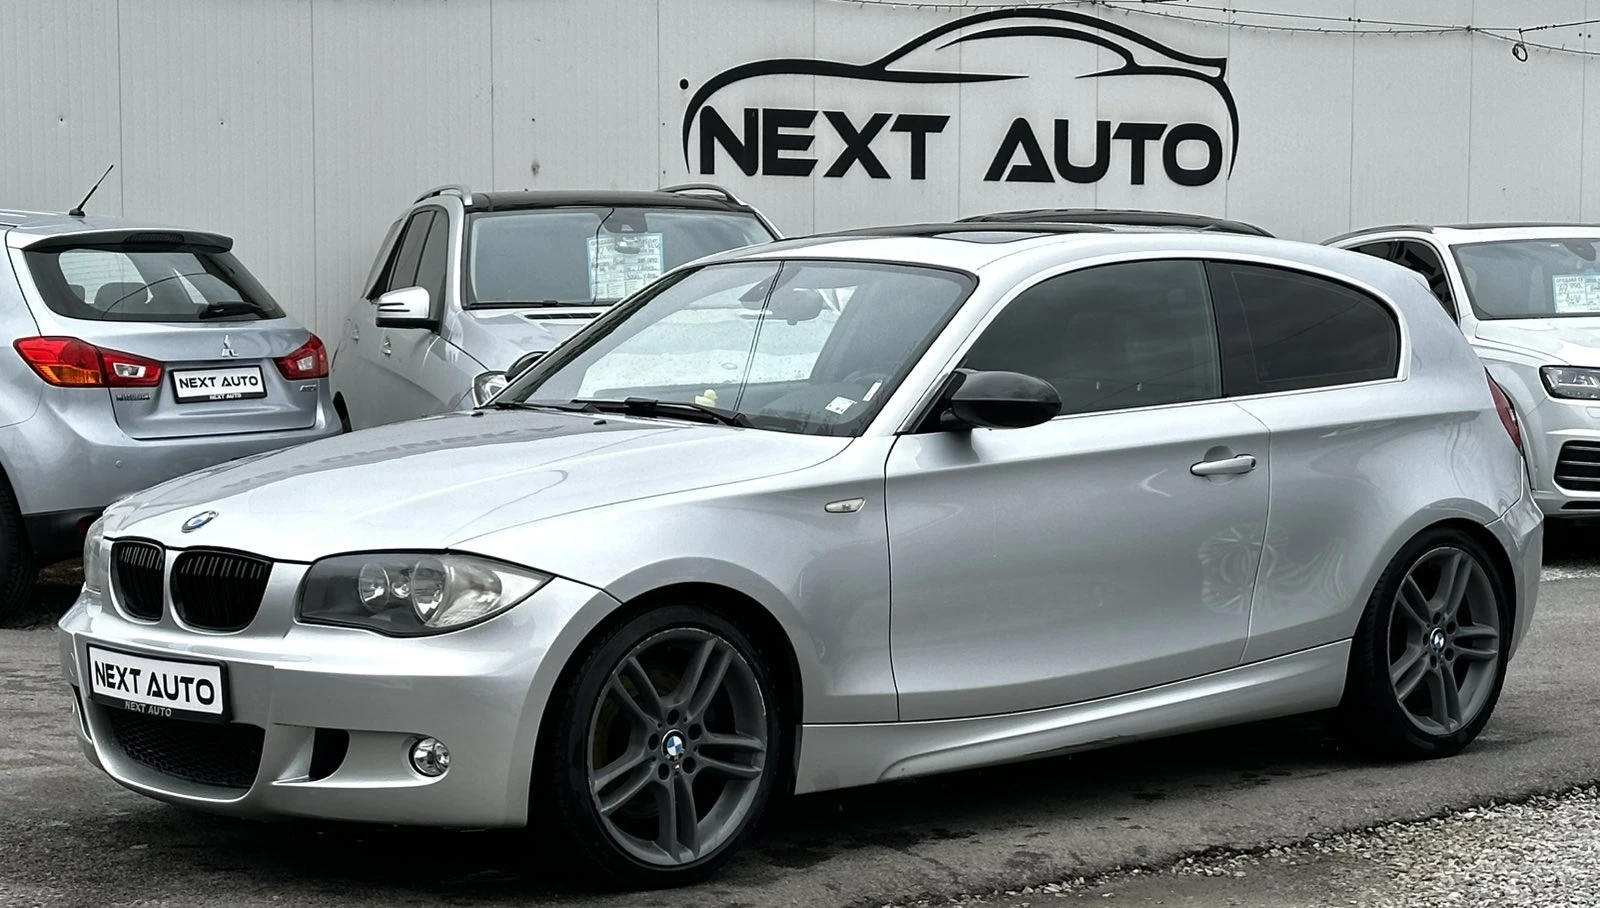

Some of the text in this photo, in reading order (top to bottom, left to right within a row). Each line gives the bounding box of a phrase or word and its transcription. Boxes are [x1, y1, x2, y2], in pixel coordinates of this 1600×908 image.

[699, 105, 1223, 187] NEXT AUTO
[179, 376, 258, 388] NEXT AUTO
[95, 661, 215, 705] NEXT AUTO
[125, 701, 171, 717] NEXT AUTO
